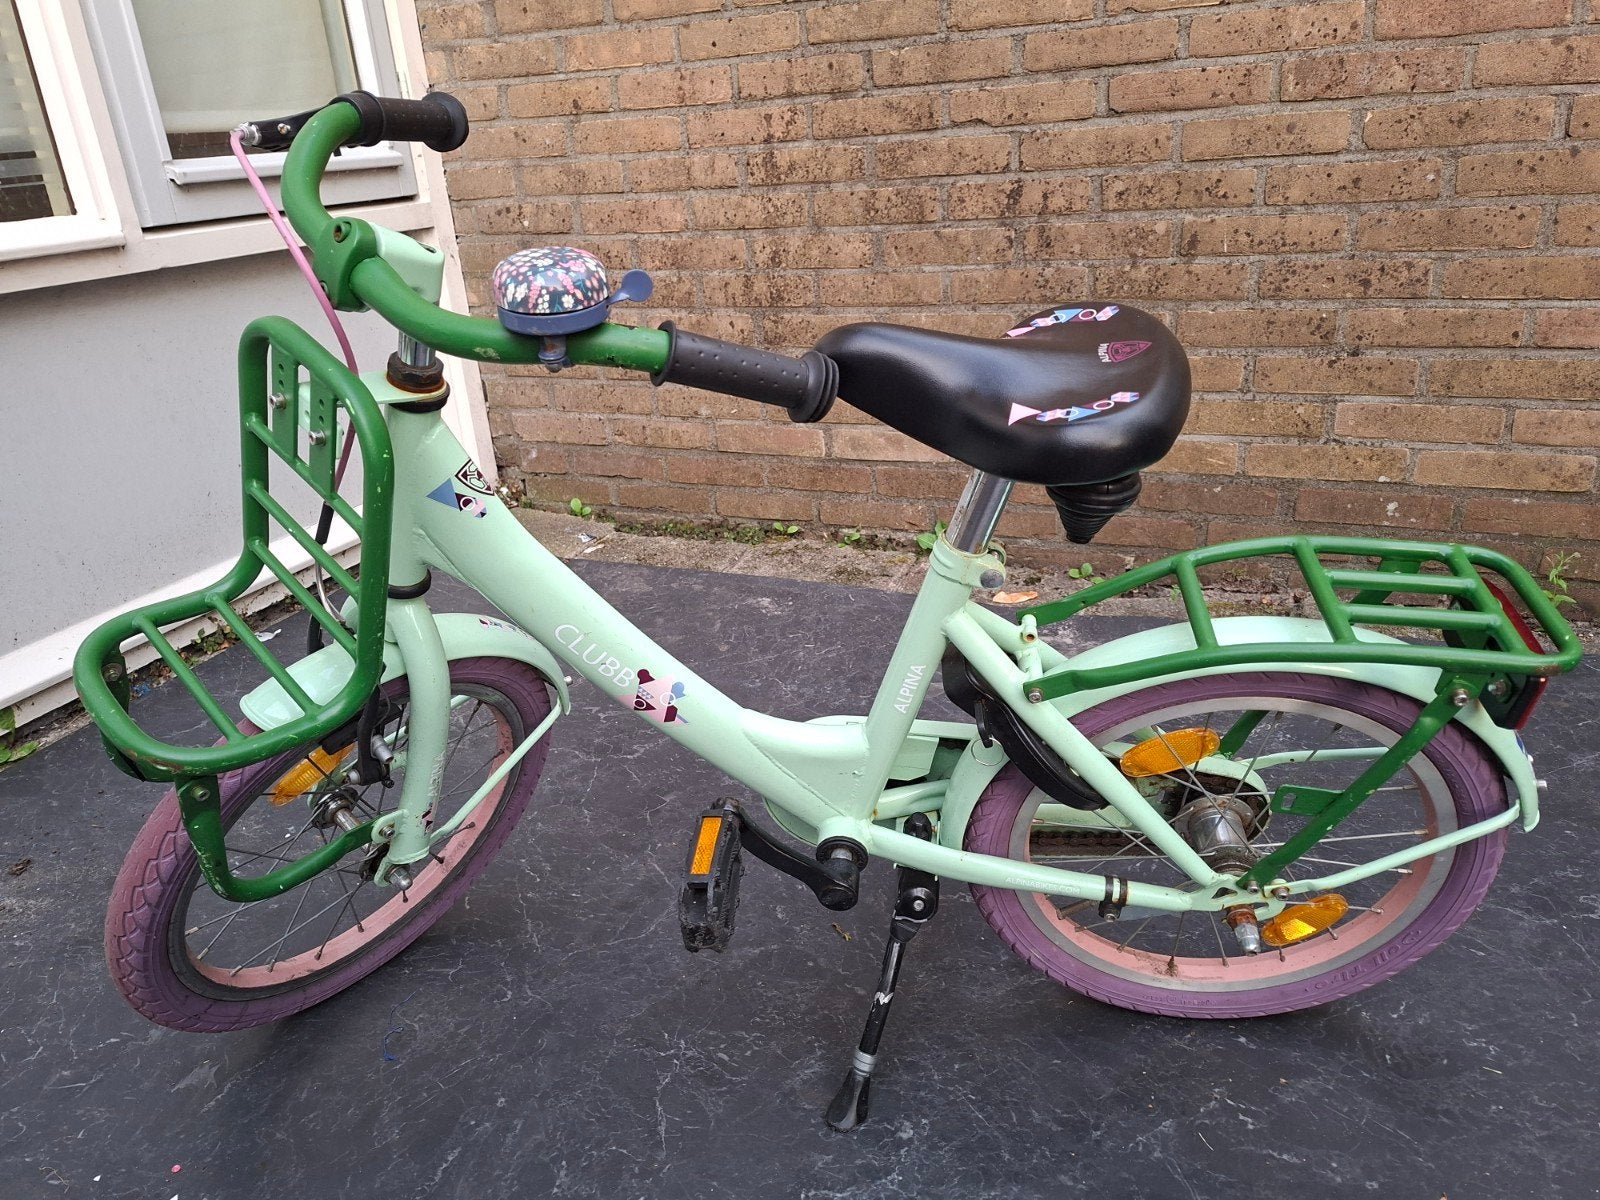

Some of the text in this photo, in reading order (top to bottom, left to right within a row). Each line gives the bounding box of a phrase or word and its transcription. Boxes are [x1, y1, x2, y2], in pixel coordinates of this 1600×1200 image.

[553, 623, 636, 688] CLUBB
[893, 664, 927, 714] ALPINA
[1005, 877, 1081, 895] ALPINABIKES.COM
